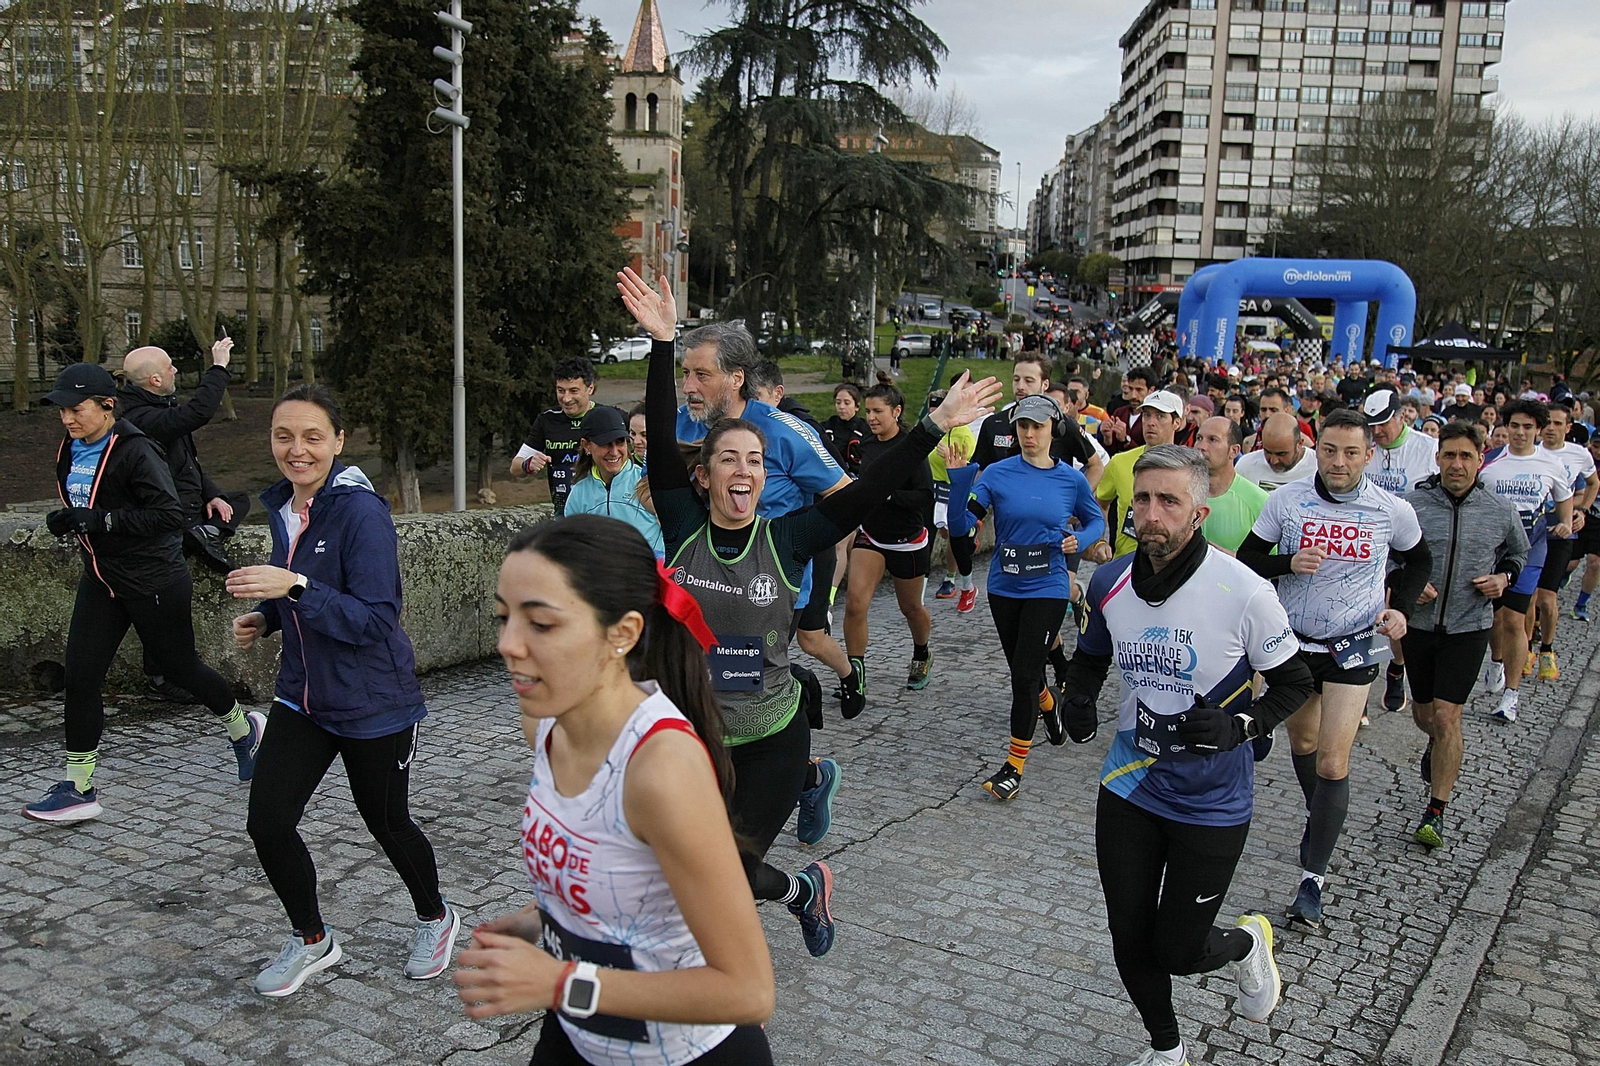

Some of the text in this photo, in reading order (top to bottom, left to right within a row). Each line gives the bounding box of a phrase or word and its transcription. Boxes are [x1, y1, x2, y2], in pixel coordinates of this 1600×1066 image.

[1284, 268, 1351, 285] mediolanum
[552, 470, 566, 478] 453
[1496, 479, 1528, 487] NOCTURNA
[1496, 485, 1536, 497] OURENSE
[1302, 522, 1374, 540] CABO DE
[1003, 548, 1017, 558] 76
[1173, 628, 1194, 645] 15K
[716, 646, 760, 657] Meixengo
[1117, 640, 1182, 661] NOCTURNA DE
[1335, 639, 1351, 652] 85
[1118, 652, 1182, 679] OURENSE
[1139, 707, 1155, 730] 257
[568, 853, 590, 875] DE
